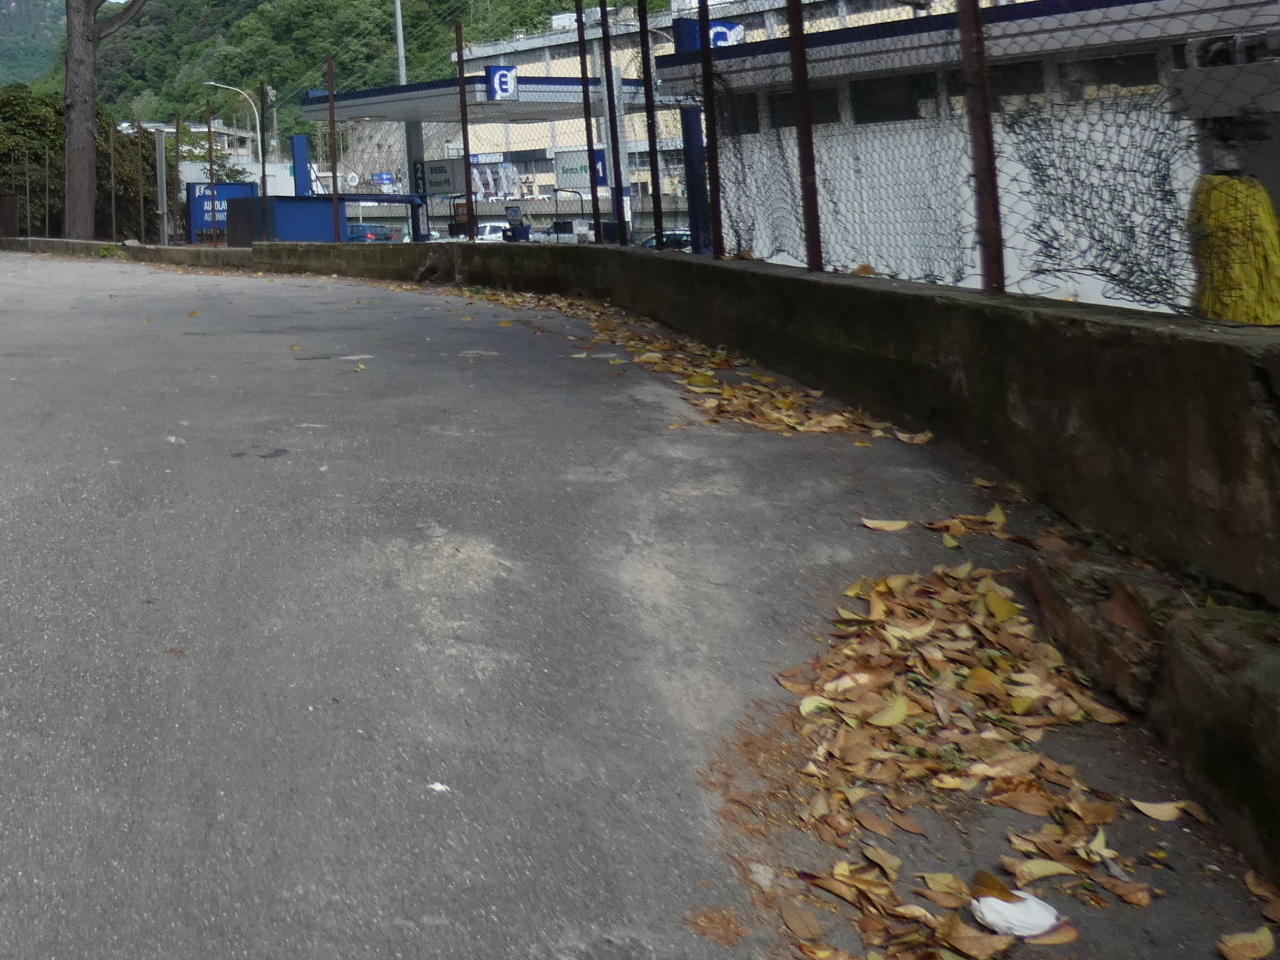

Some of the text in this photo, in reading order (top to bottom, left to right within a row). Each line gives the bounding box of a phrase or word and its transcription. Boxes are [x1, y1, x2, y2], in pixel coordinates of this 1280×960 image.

[429, 165, 447, 174] DIESEL
[596, 161, 603, 177] 1
[204, 201, 227, 210] AUOLA
